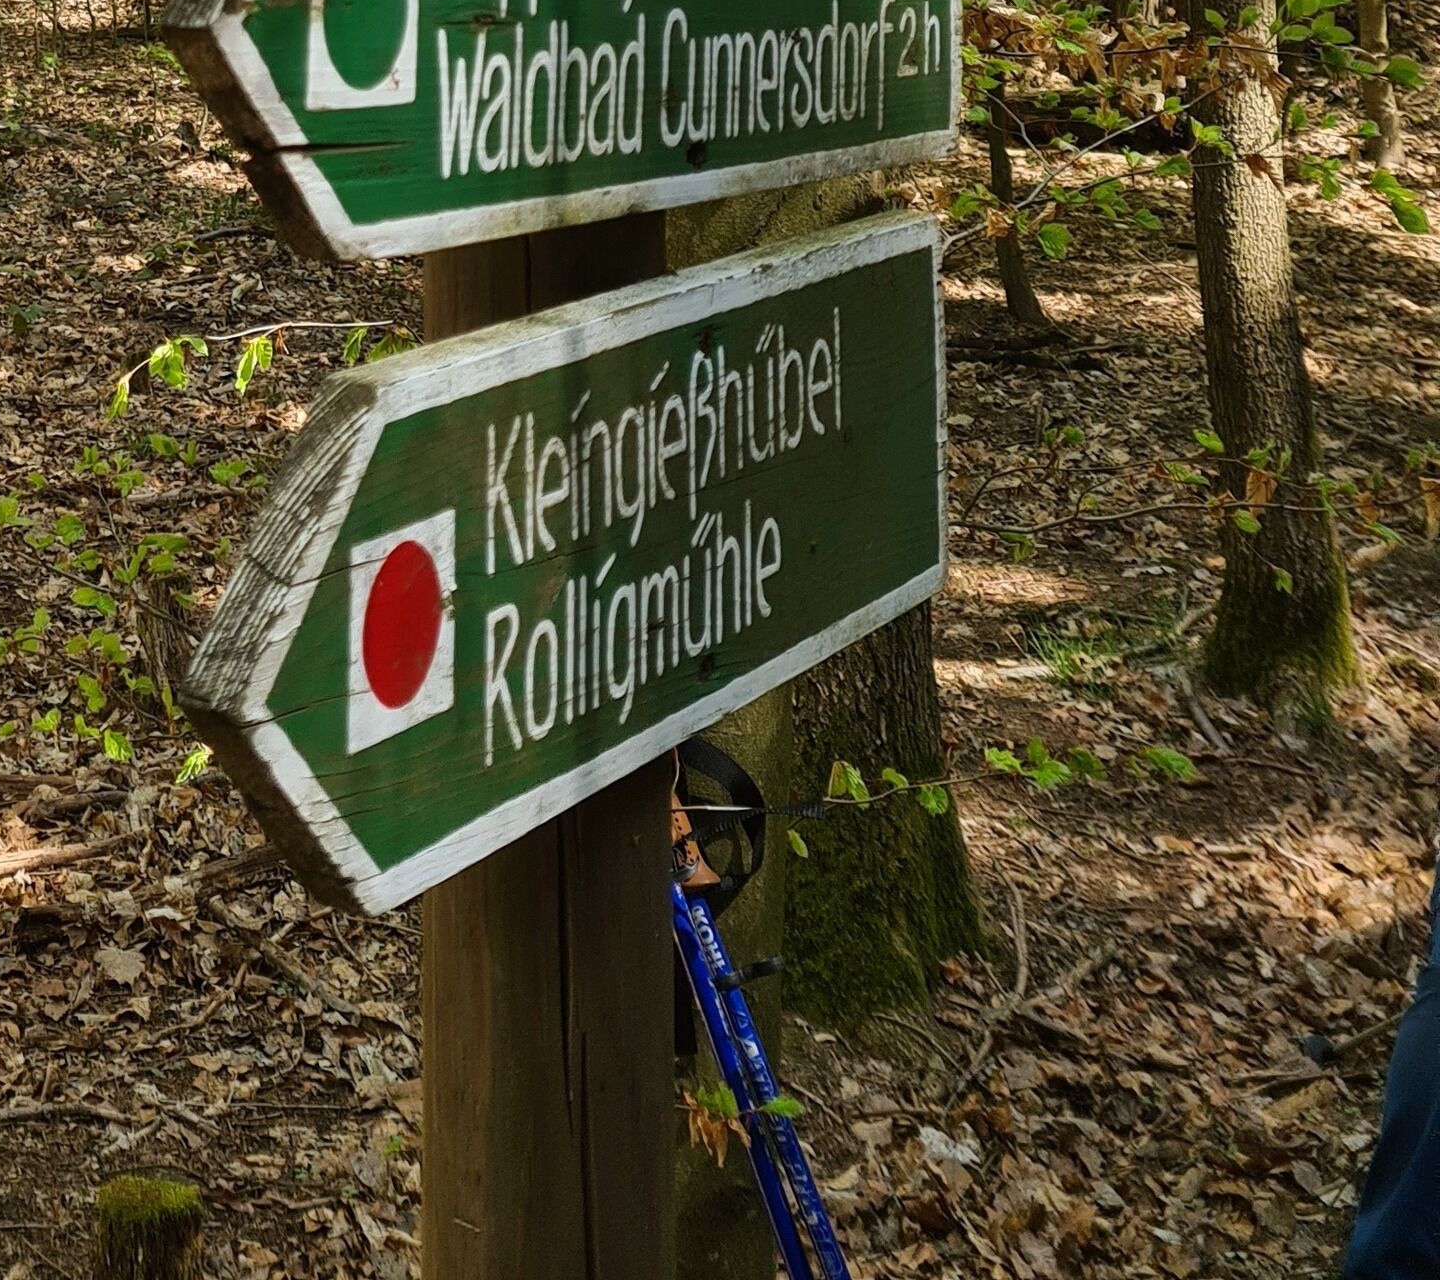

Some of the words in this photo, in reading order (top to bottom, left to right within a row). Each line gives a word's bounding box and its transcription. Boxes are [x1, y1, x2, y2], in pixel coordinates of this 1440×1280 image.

[437, 12, 646, 180] Waldbad
[485, 305, 842, 578] Kleingießhübel
[483, 498, 782, 768] Rolligmühle
